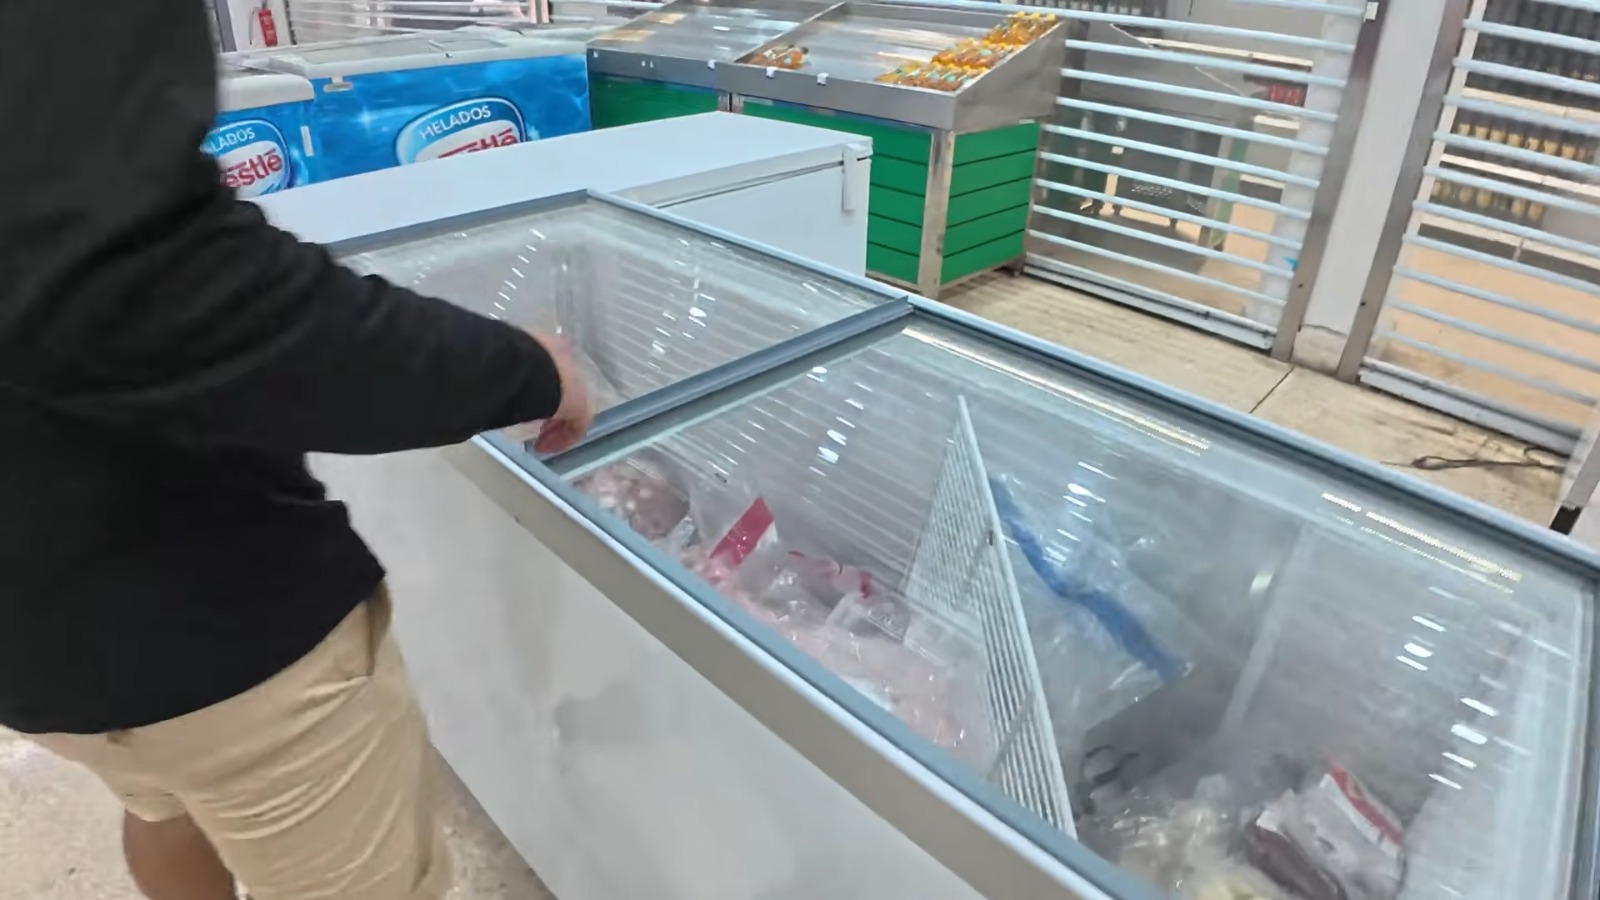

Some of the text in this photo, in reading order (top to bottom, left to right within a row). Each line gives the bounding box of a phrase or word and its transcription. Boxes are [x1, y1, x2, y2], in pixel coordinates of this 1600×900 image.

[209, 127, 256, 152] LADOS
[420, 105, 492, 140] HELADOS
[221, 148, 283, 188] estlé
